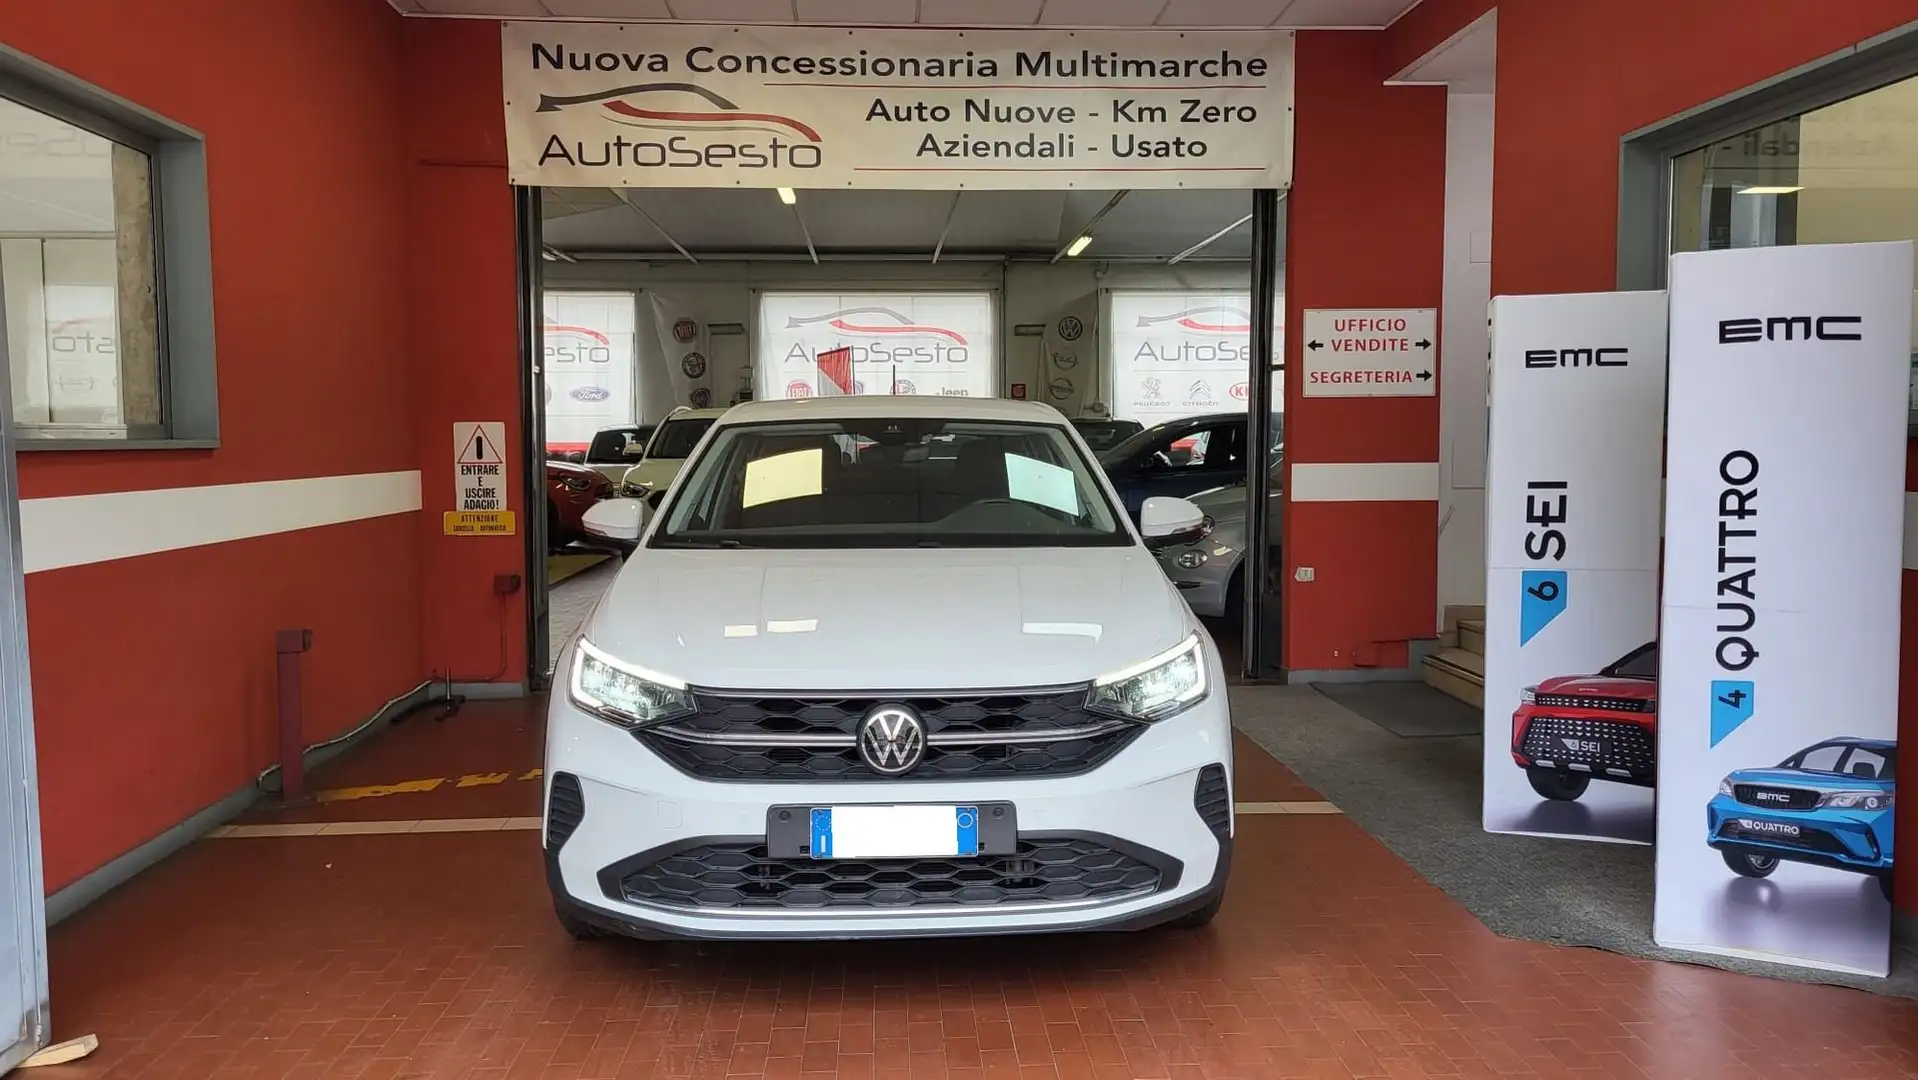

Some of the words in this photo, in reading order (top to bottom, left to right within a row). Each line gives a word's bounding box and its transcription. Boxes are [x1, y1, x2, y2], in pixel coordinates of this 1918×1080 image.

[532, 43, 669, 73] Nuova
[686, 46, 998, 78] Concessionaria
[1015, 51, 1268, 78] Multimarche
[865, 98, 951, 122] Auto
[965, 99, 1076, 124] Nuove
[1113, 99, 1167, 124] Km
[1180, 99, 1258, 124] Zero
[538, 134, 822, 169] AutoSesto
[916, 133, 1075, 158] Aziendali
[1112, 134, 1208, 159] Usato
[1335, 319, 1406, 332] UFFICIO
[1331, 338, 1408, 352] VENDITE
[1310, 371, 1413, 384] SEGRETERIA
[461, 465, 499, 475] ENTRARE
[478, 476, 483, 487] E
[465, 488, 496, 498] USCIRE
[464, 500, 499, 509] ADAGIO!
[1525, 481, 1568, 562] SEI
[1715, 450, 1760, 671] QUATTRO
[1527, 580, 1560, 601] 6
[1718, 690, 1747, 708] 4
[1580, 740, 1600, 753] SEI
[1753, 821, 1800, 836] QUATTRO
